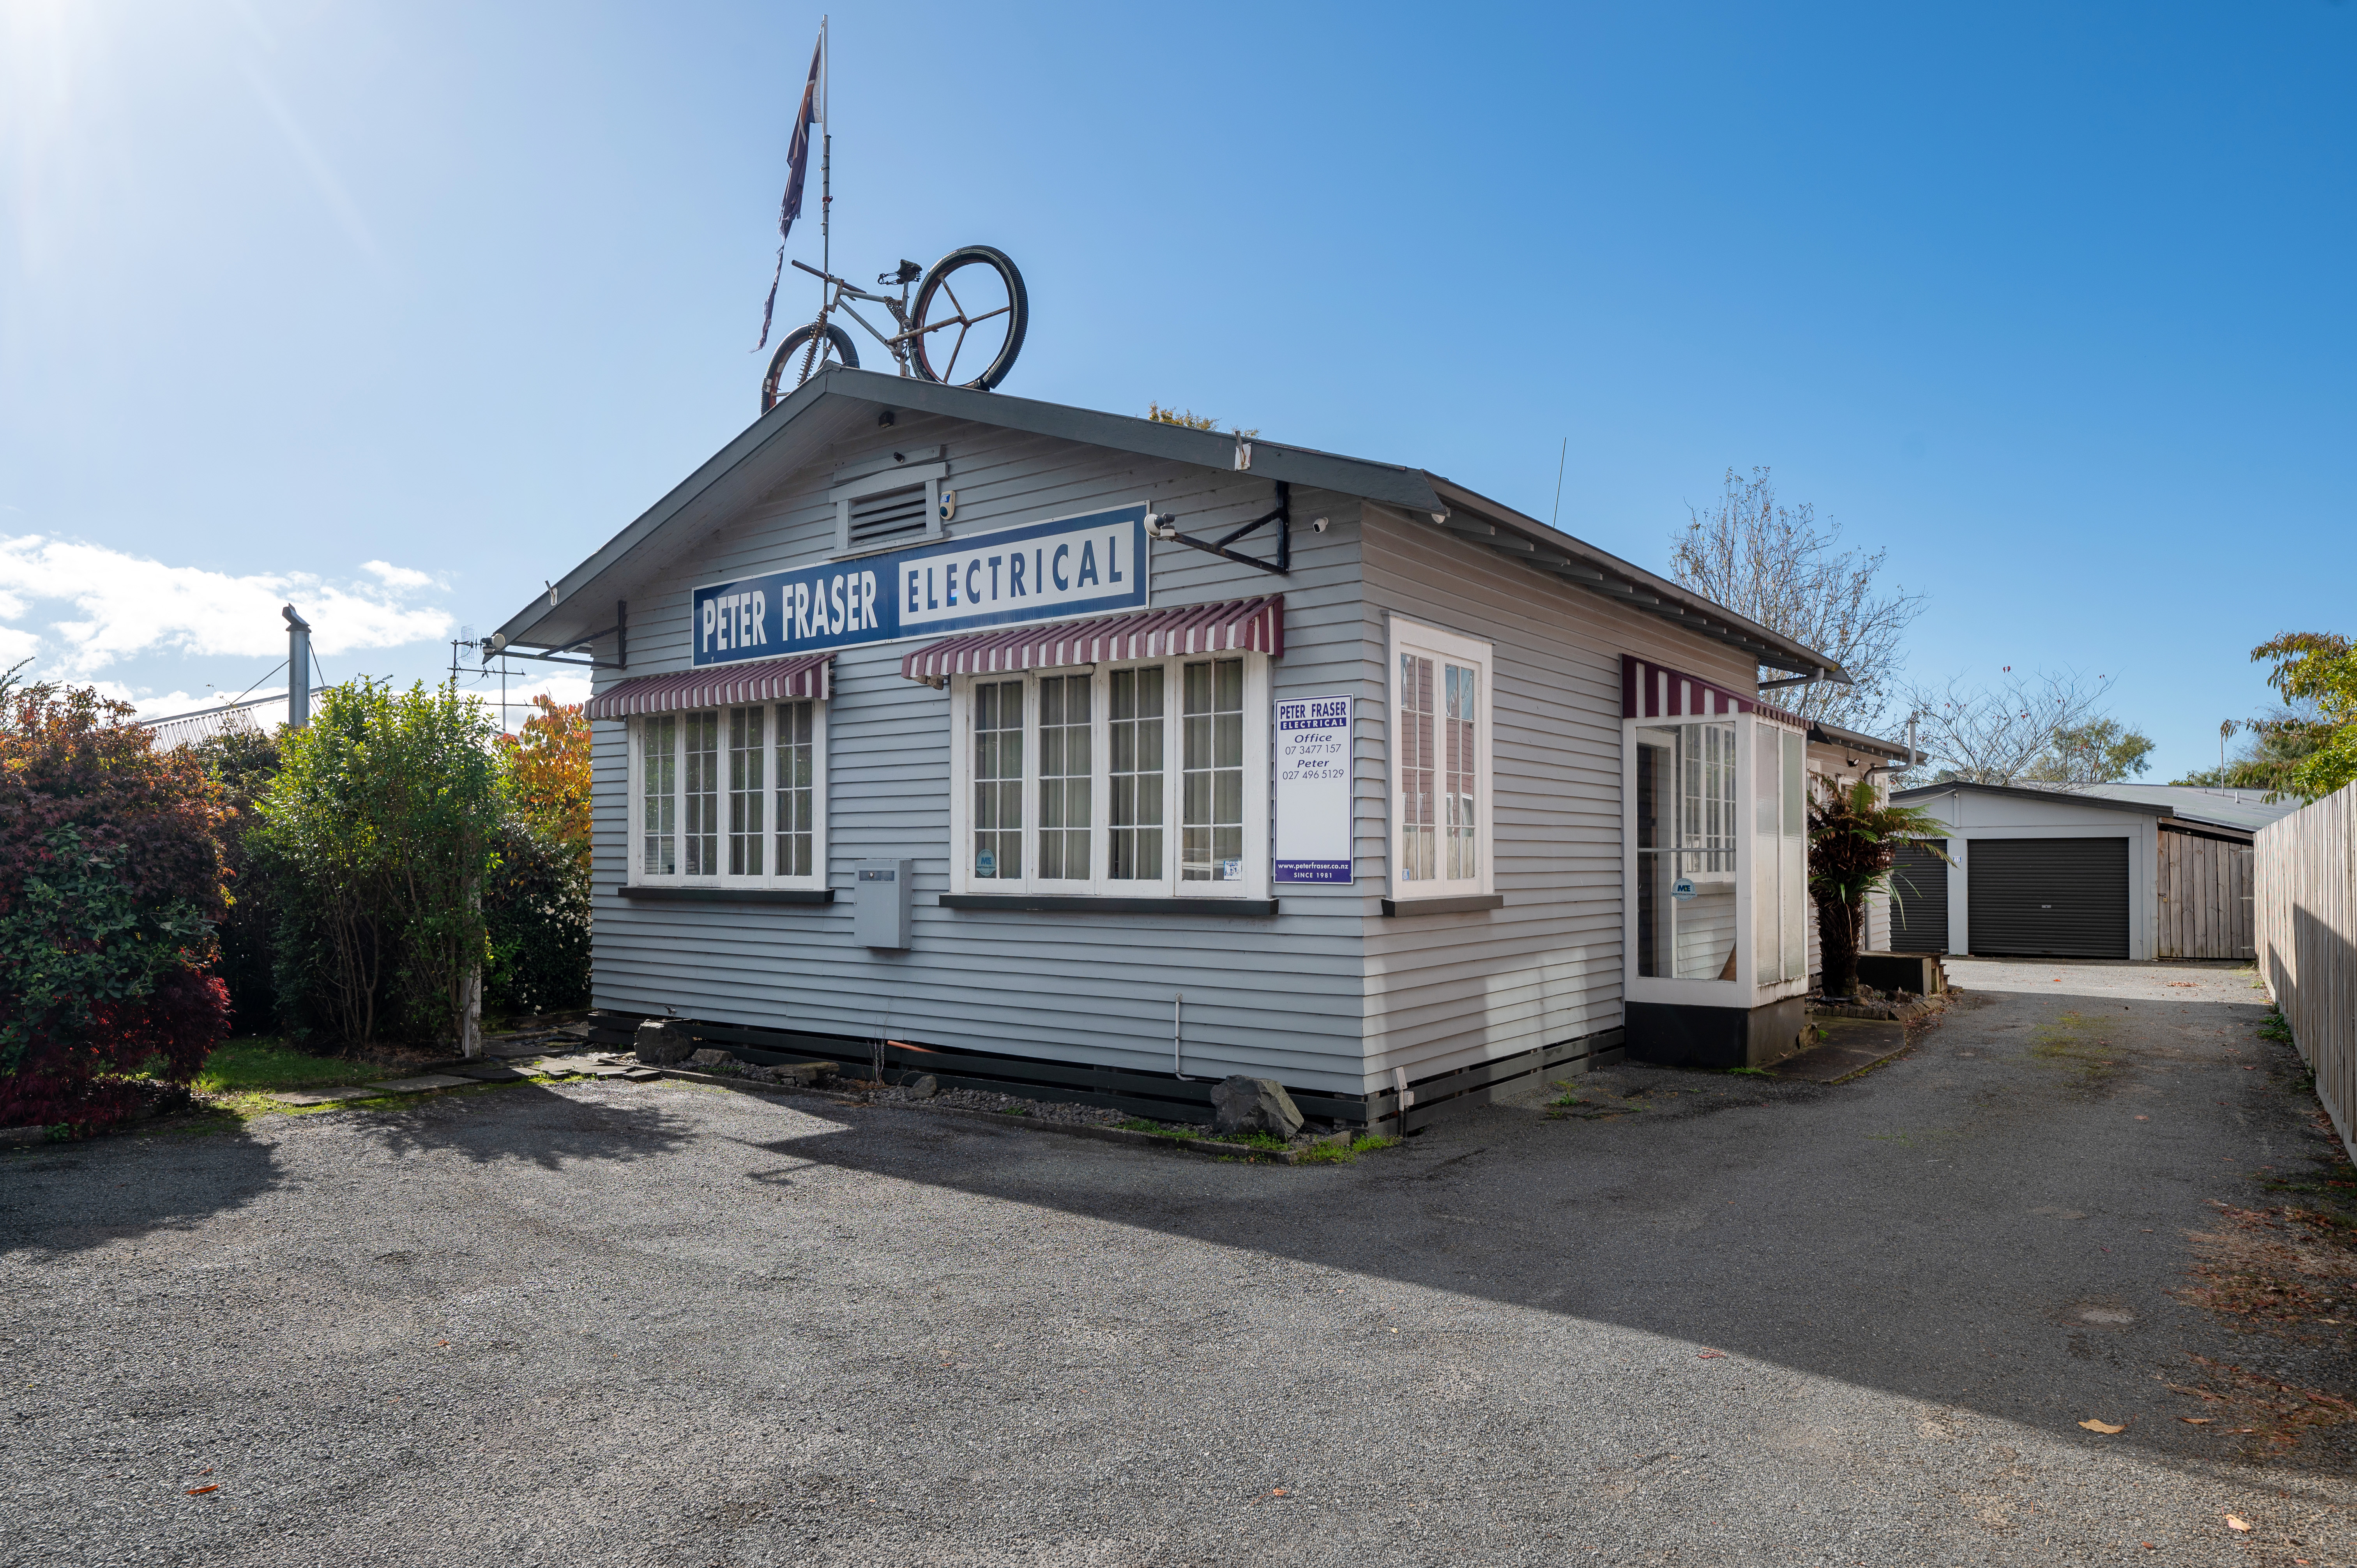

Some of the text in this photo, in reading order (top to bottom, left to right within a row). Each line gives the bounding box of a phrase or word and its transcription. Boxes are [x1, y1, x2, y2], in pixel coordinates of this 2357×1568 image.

[908, 536, 1122, 613] ELECTRICAL
[703, 570, 878, 653] PETER FRASER
[1280, 701, 1346, 719] PETER FRASER
[1283, 719, 1343, 729] ELECTRICAL
[1295, 733, 1332, 743] Office
[1285, 744, 1341, 755] 07 3477 157
[1297, 759, 1329, 768] Peter
[1283, 769, 1344, 780] 027 496 5129
[1278, 862, 1348, 871] www.peterfraser.co.nz
